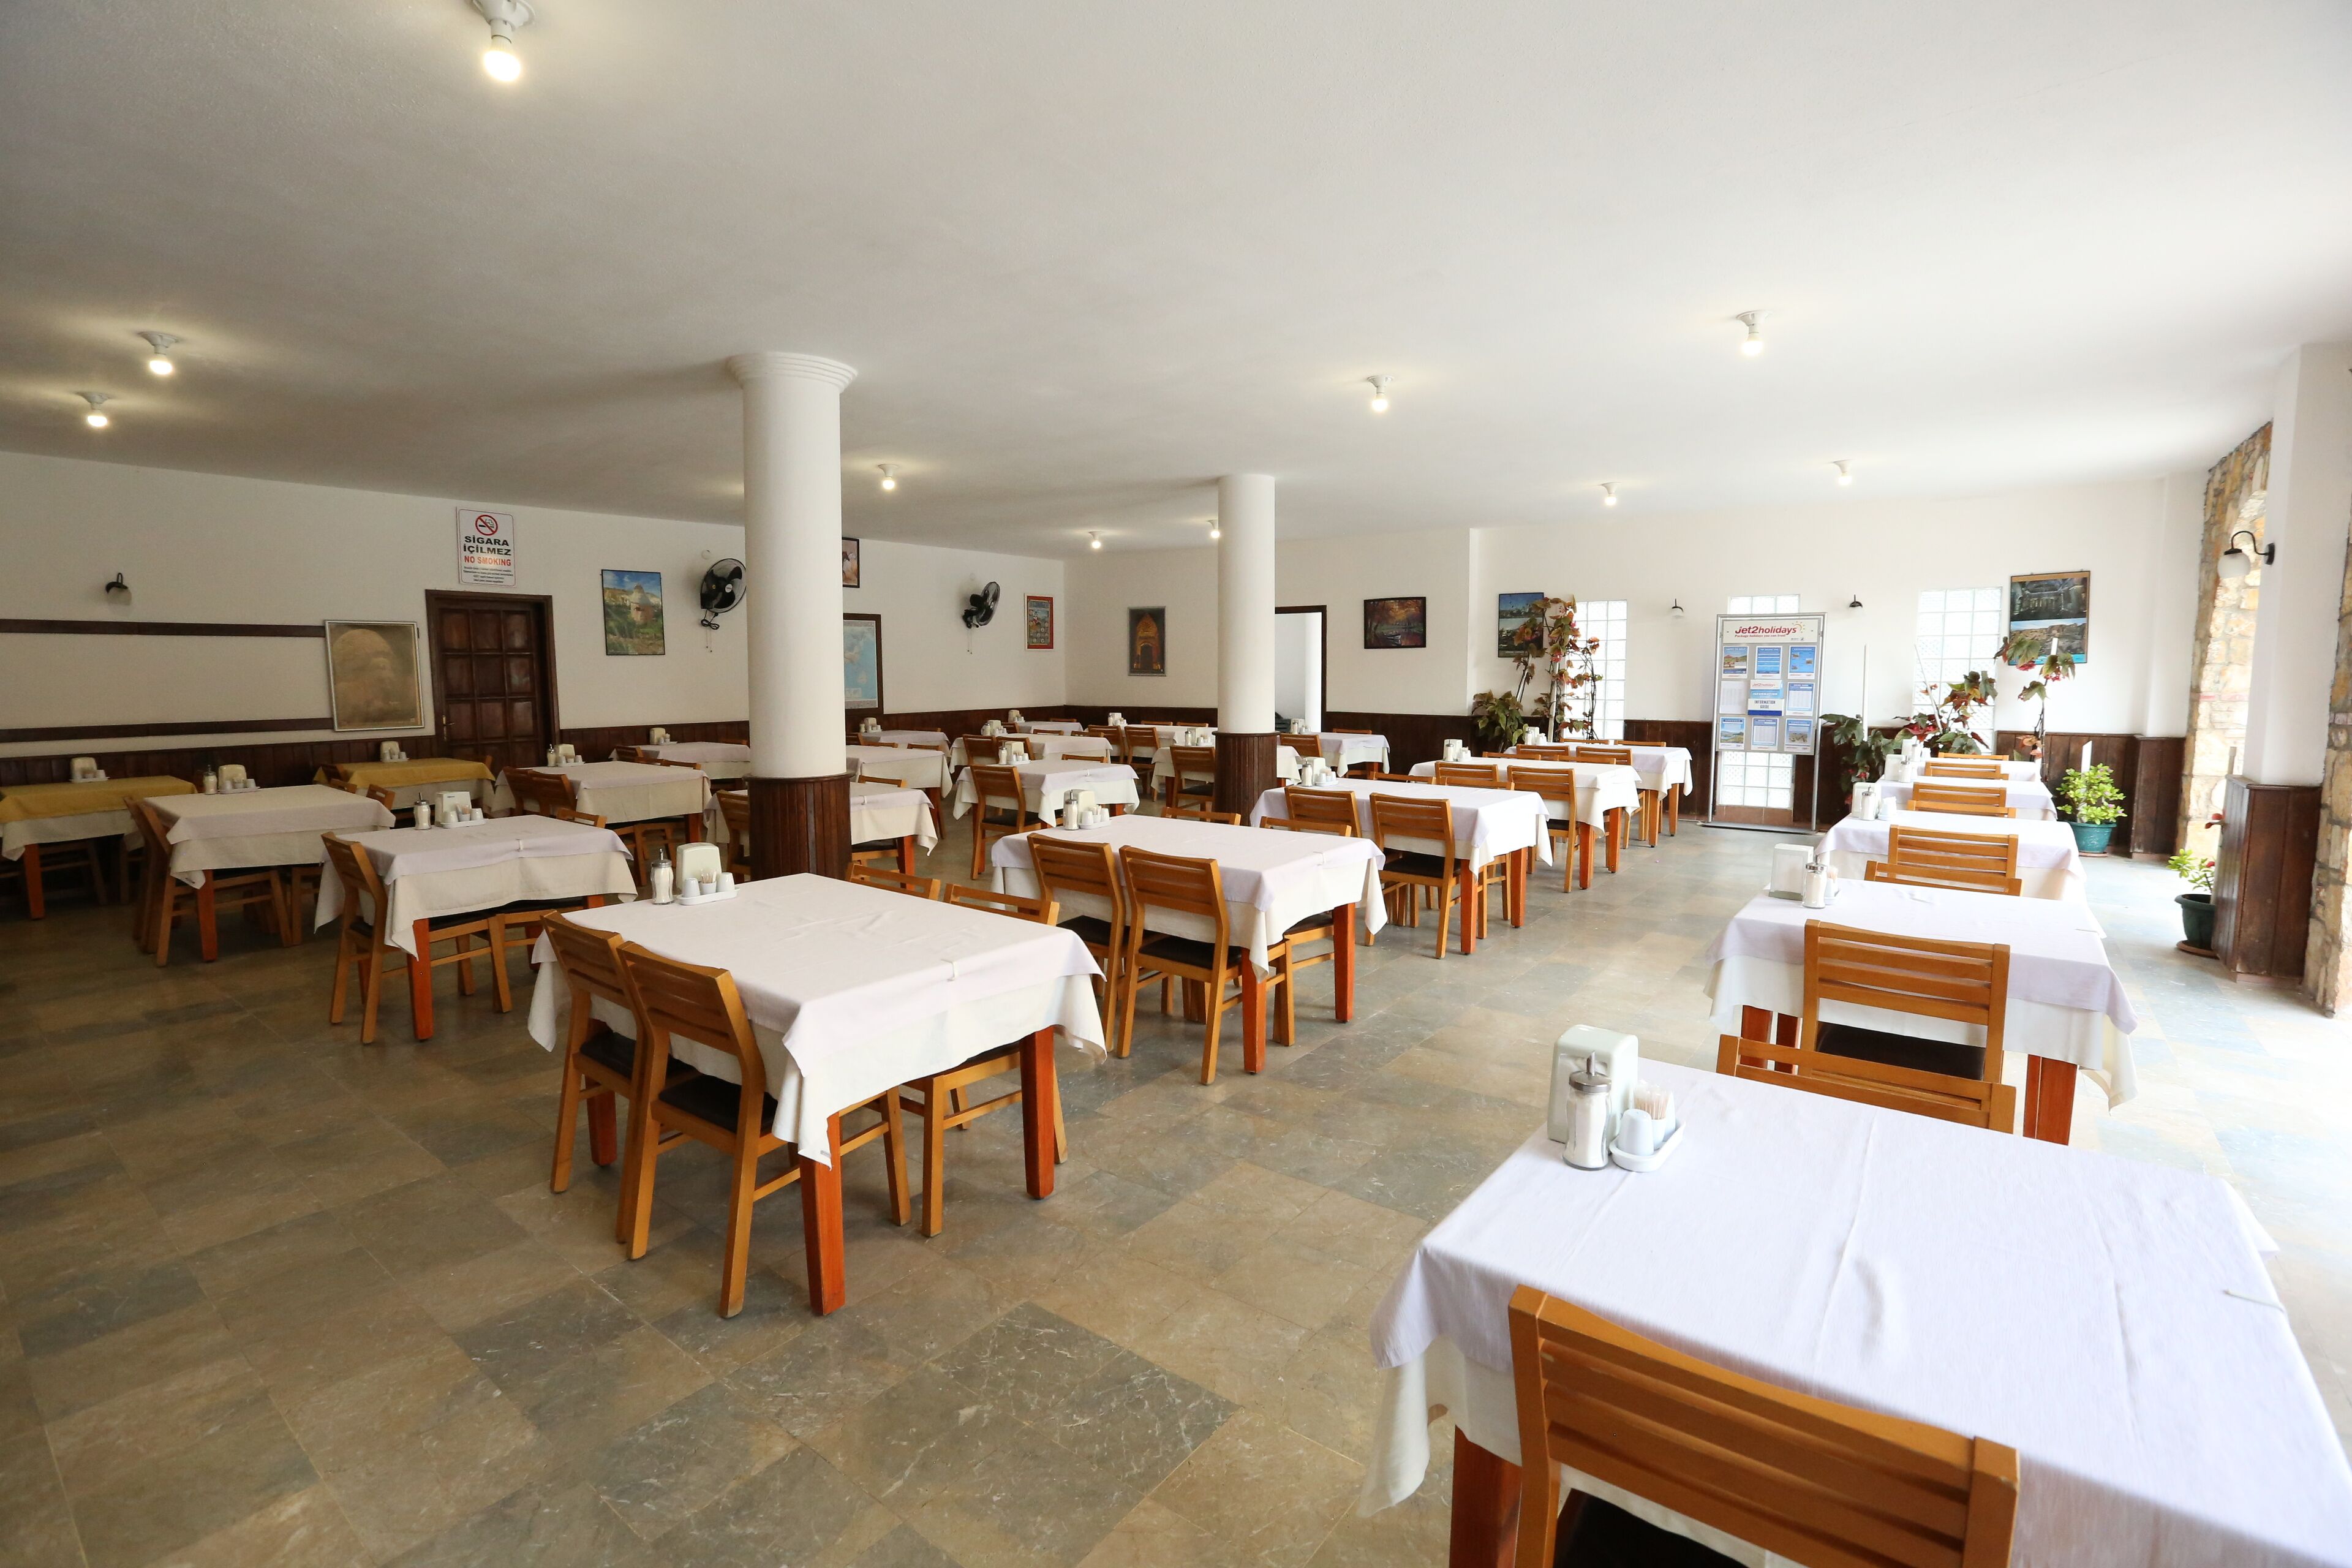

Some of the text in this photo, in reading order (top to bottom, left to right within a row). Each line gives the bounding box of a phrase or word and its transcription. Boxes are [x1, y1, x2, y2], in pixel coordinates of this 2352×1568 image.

[464, 535, 509, 546] SİGARA
[463, 544, 511, 556] İÇİLMEZ
[477, 557, 511, 566] SMOKING
